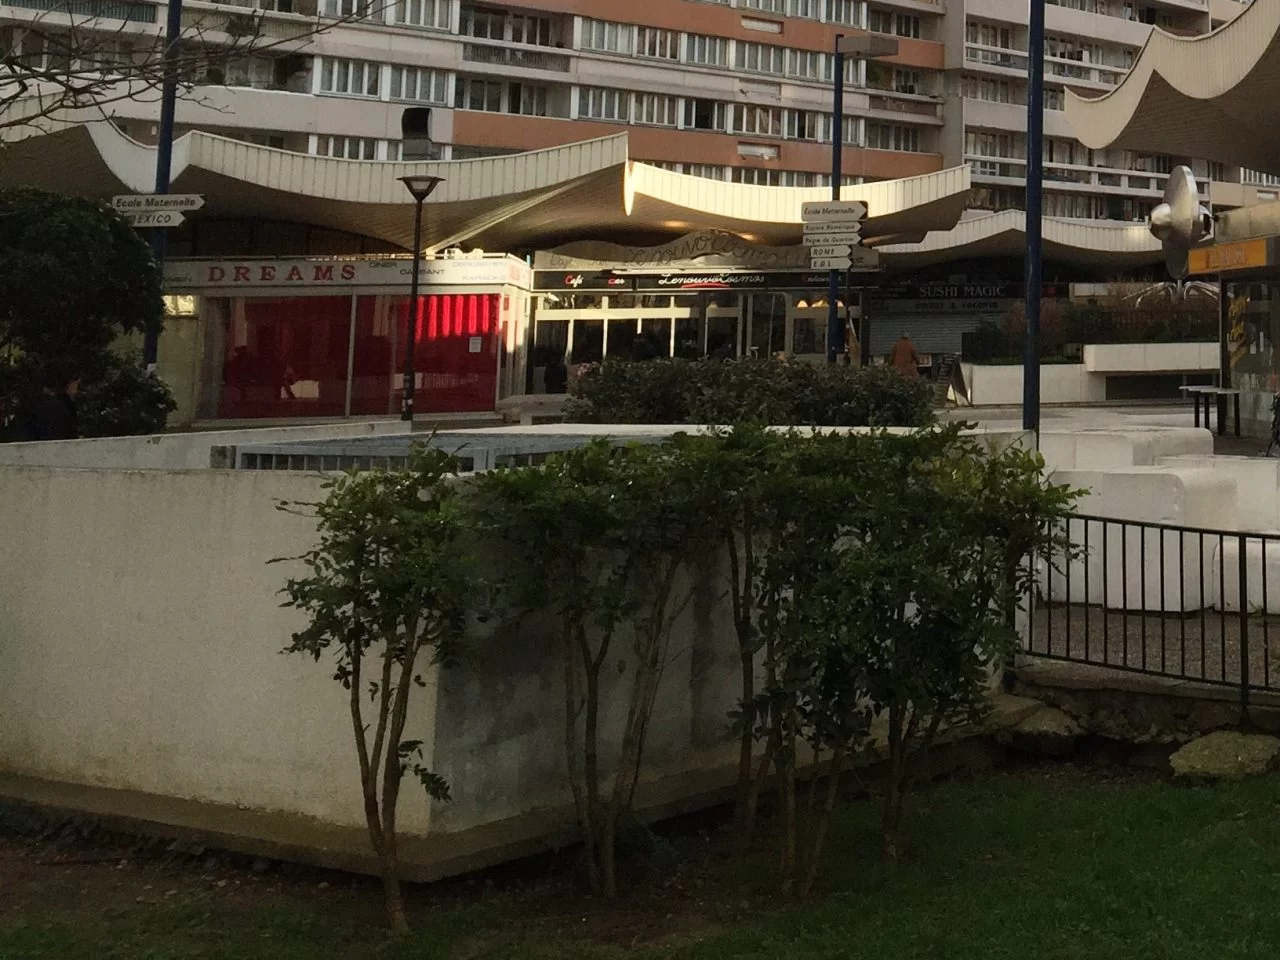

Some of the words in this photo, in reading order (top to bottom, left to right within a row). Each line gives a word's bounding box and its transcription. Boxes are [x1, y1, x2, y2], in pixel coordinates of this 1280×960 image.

[116, 199, 143, 208] Ecole
[144, 198, 196, 208] Maternelle
[136, 214, 172, 224] EXICO
[207, 264, 356, 282] DREAMS
[400, 268, 446, 276] DASANT
[919, 286, 959, 297] SUSHI
[963, 286, 1005, 297] MAGIC
